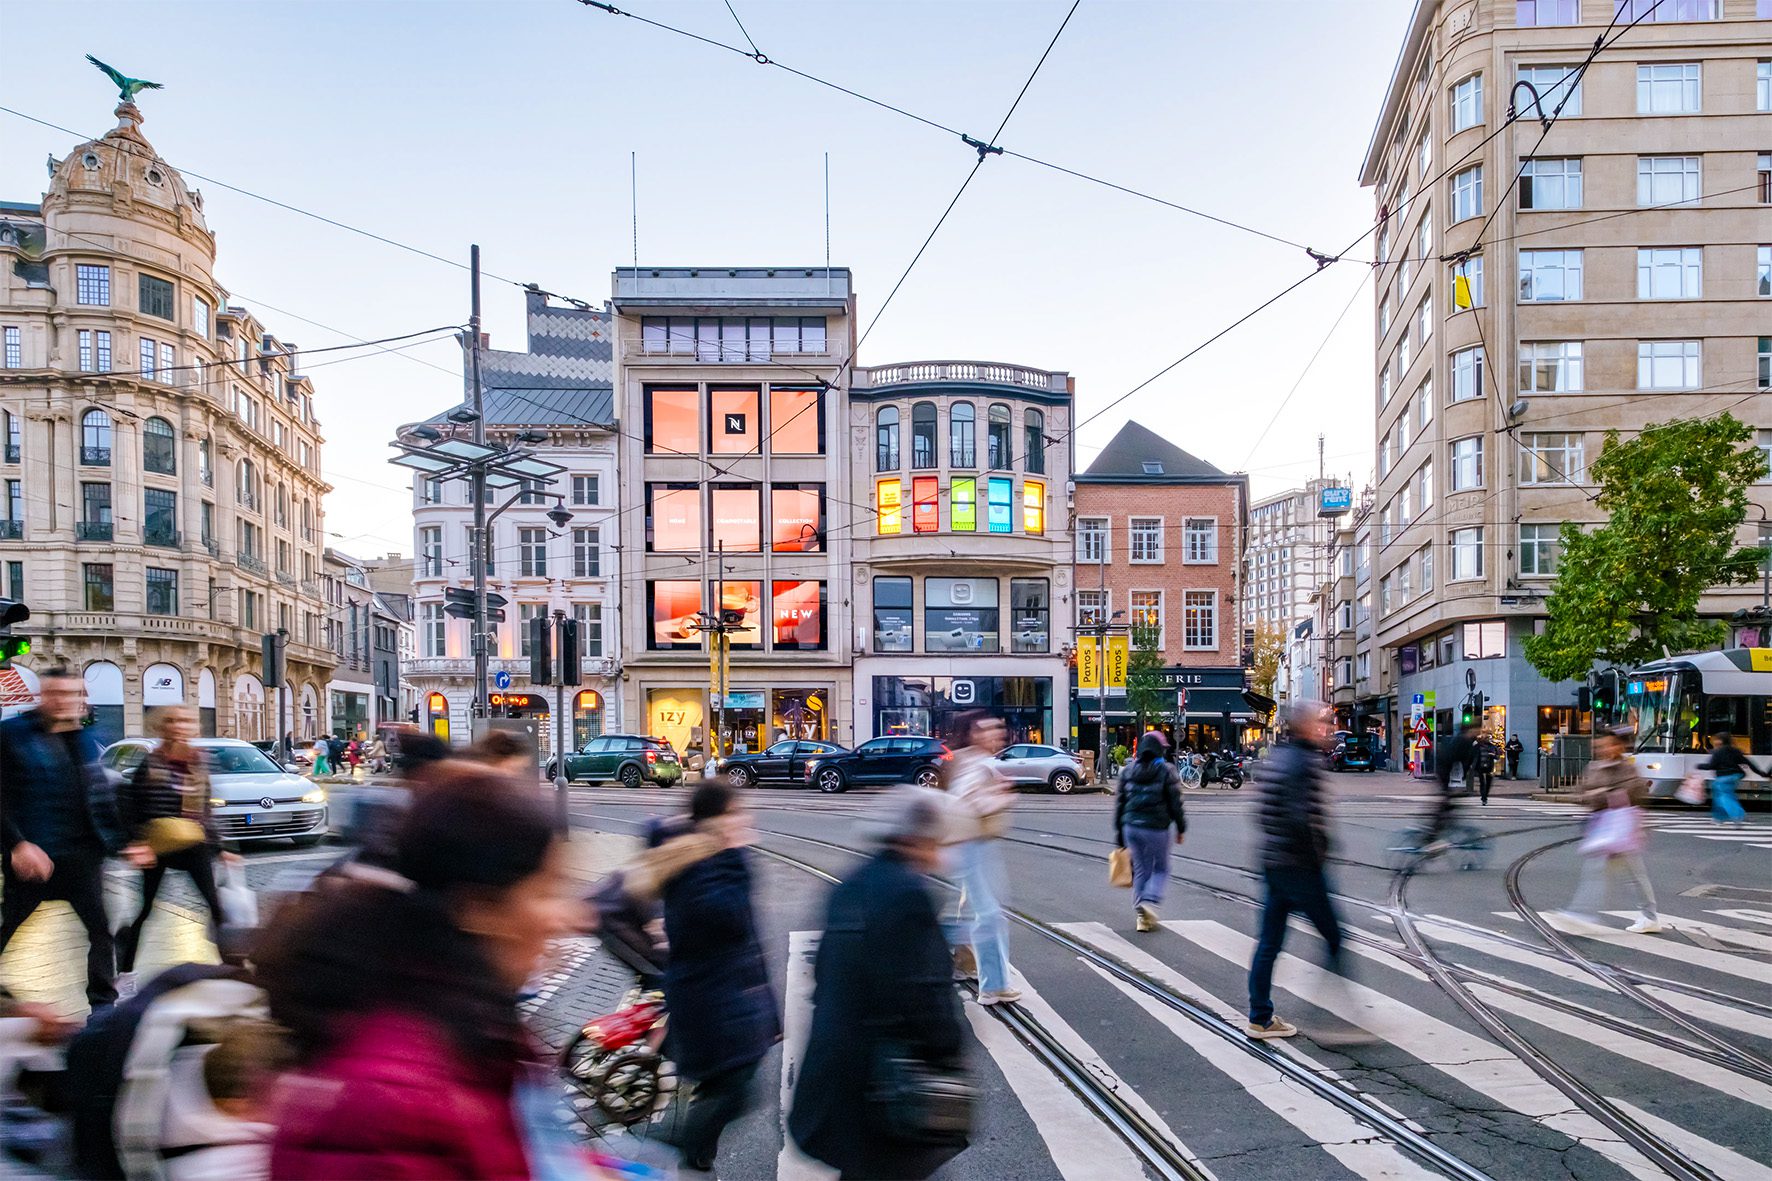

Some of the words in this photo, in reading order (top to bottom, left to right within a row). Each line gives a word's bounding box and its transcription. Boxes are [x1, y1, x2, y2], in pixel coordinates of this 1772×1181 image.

[780, 609, 813, 619] NEW
[1083, 649, 1091, 683] Panos
[1113, 649, 1122, 683] Panos
